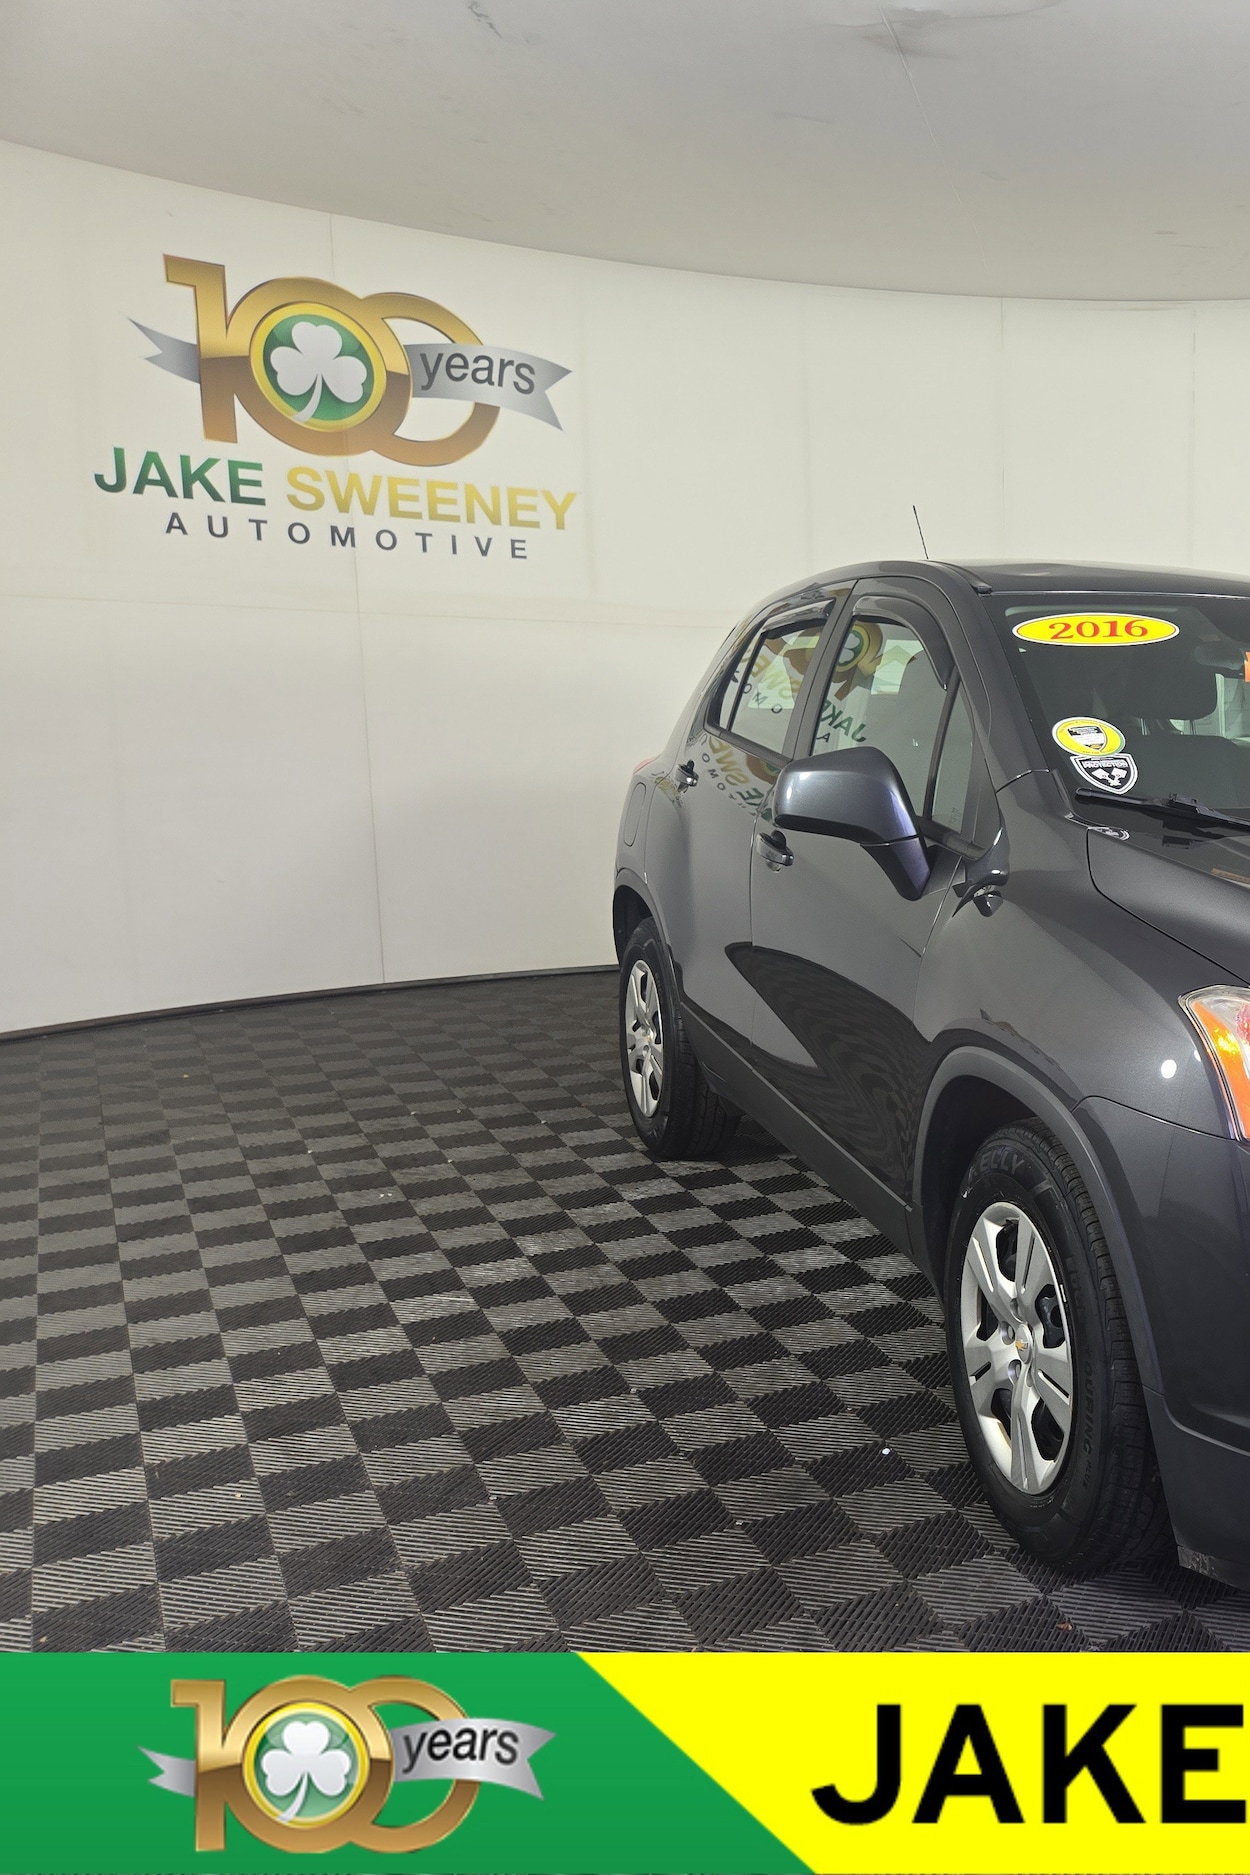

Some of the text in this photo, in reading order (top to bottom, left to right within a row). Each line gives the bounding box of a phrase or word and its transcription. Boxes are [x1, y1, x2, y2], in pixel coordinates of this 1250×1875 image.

[420, 352, 537, 395] years
[94, 446, 578, 531] JAKE SWEENEY
[165, 512, 529, 560] AUTOMOTIVE
[1048, 619, 1150, 640] 2016
